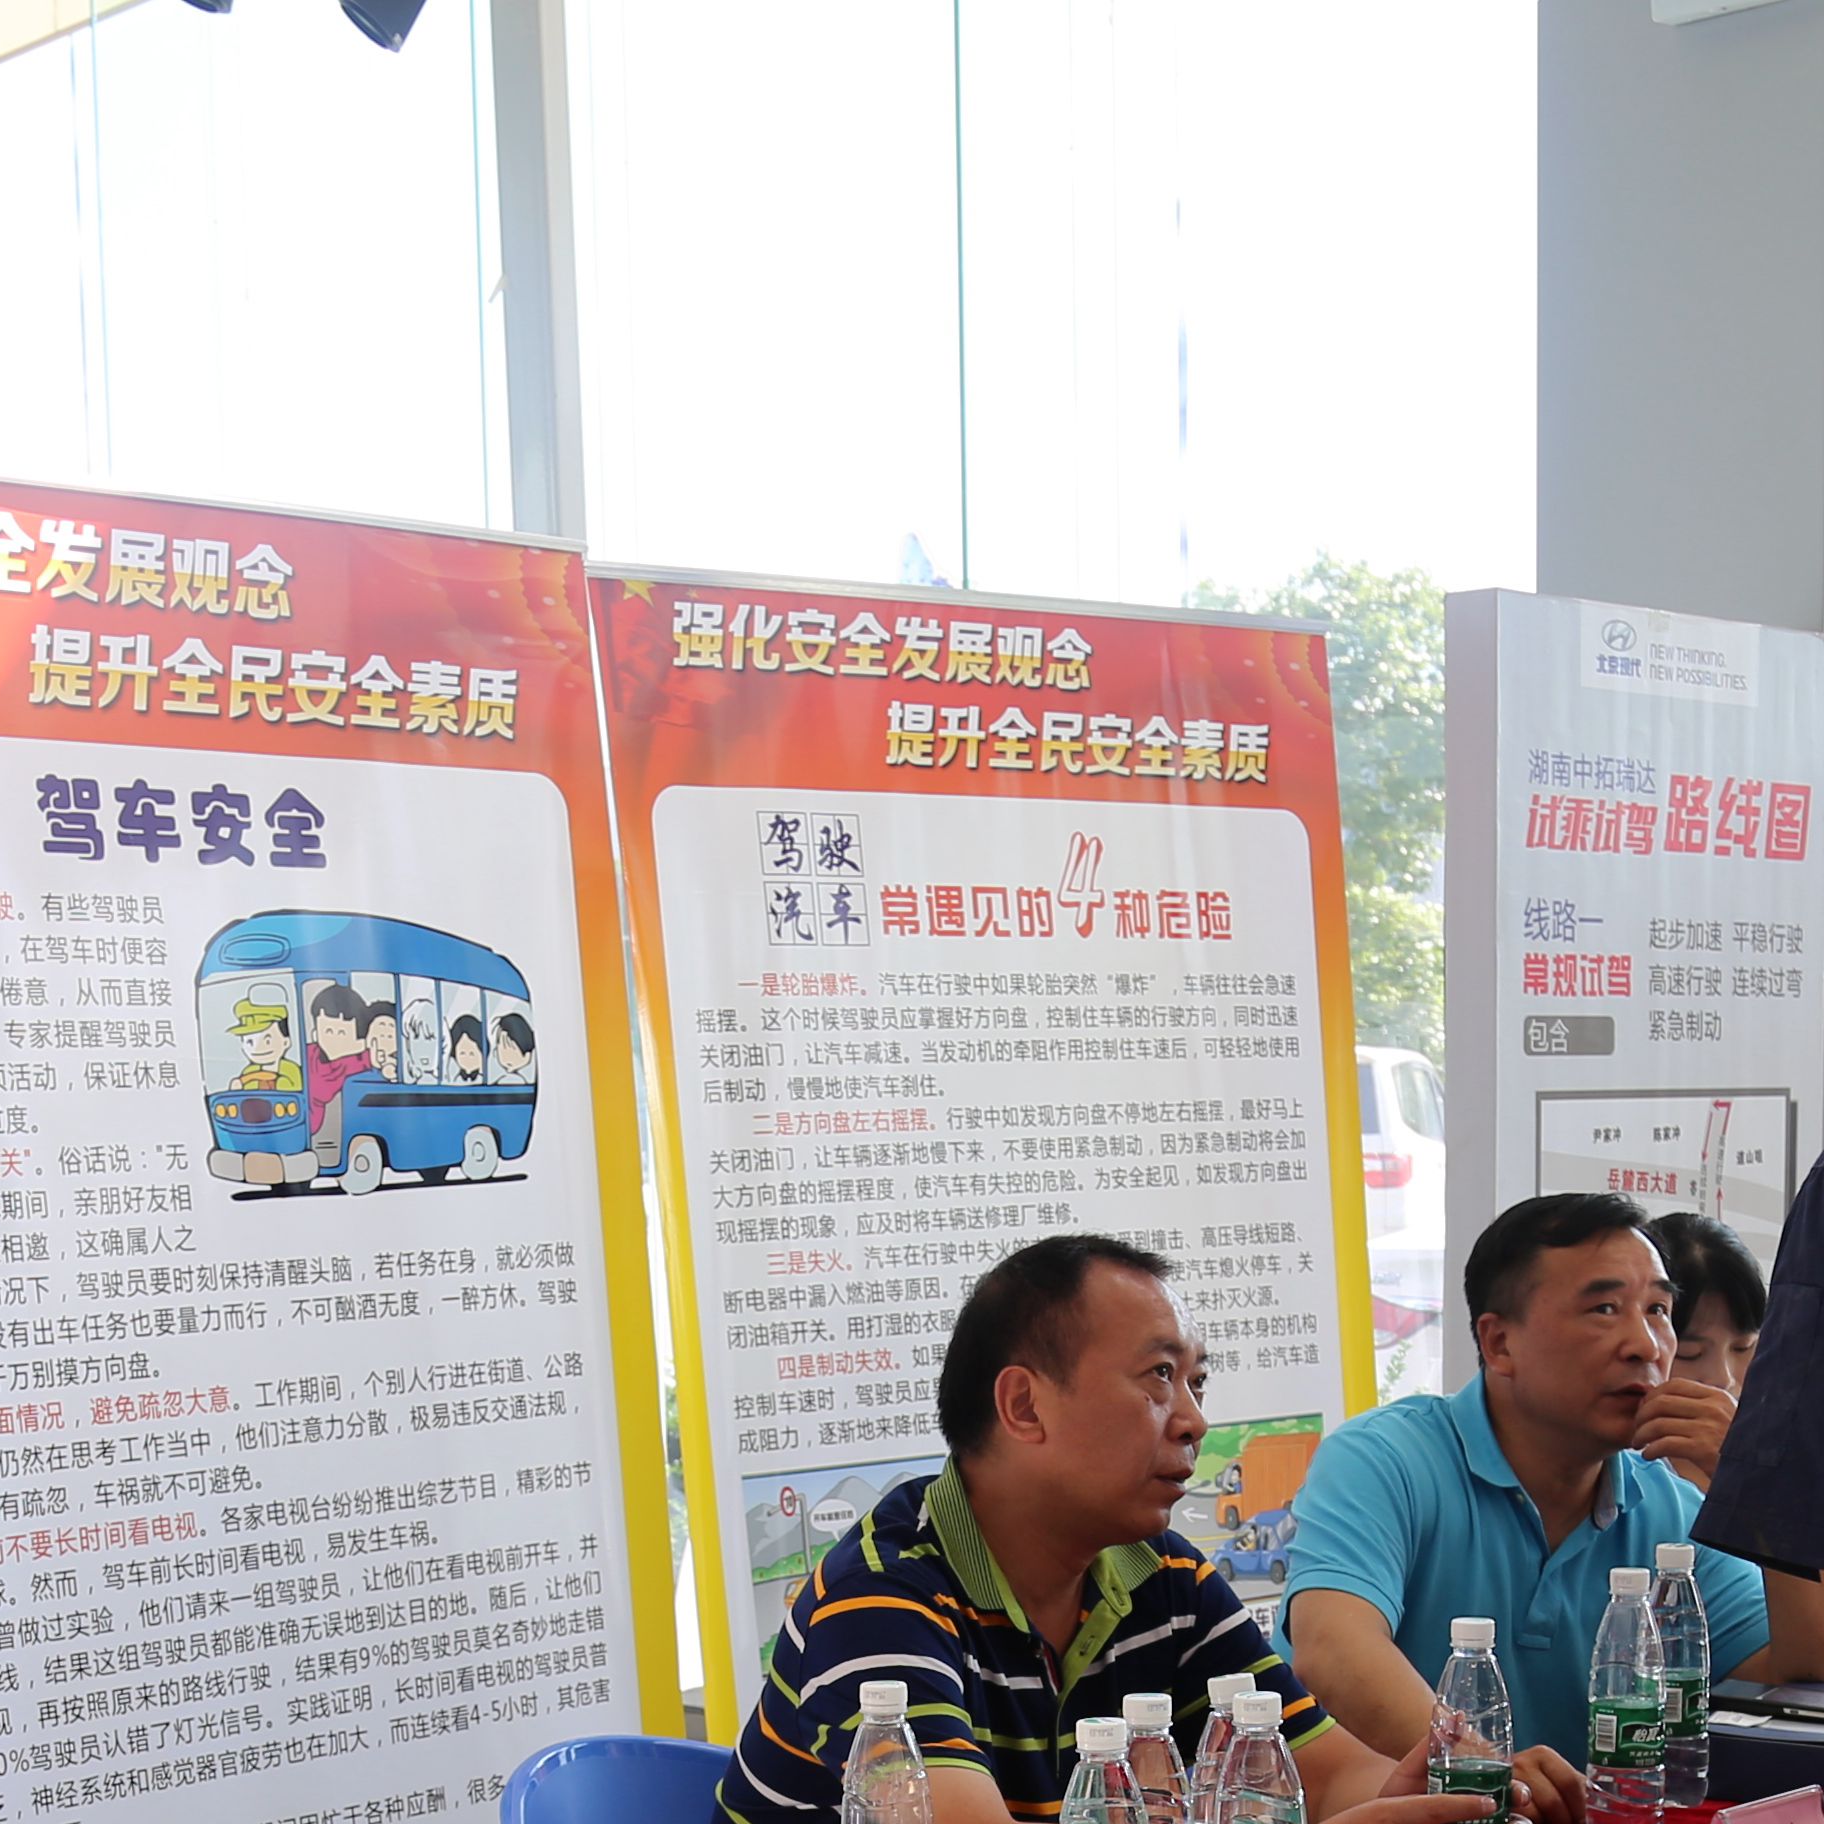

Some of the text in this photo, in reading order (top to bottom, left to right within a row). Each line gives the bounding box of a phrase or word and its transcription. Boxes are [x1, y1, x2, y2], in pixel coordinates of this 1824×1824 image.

[673, 602, 1093, 691] 强化安全发展观念
[1596, 653, 1642, 678] 北京现代
[1650, 643, 1673, 660] NEW
[29, 626, 518, 740] 提升全民安全素质
[1649, 663, 1674, 681] NEW
[886, 701, 1270, 784] 提升全民安全素质
[1527, 748, 1656, 796] 湖南中拓瑞达
[36, 774, 328, 870] 驾车安全
[1526, 774, 1812, 862] 试乘试驾 路线图
[763, 814, 863, 873] 驾驶
[880, 831, 1233, 940] 常遇见的4种危险
[769, 884, 862, 944] 汽车
[1523, 897, 1604, 944] 线路一
[1648, 916, 1804, 955] 起步加速 平稳行驶
[1523, 953, 1632, 998] 常规试驾
[1648, 964, 1804, 999] 高速行驶 连续过弯
[1527, 1018, 1570, 1055] 包含
[1648, 1008, 1722, 1043] 紧急制动
[703, 1074, 947, 1105] 后制动，慢慢地使汽车刹住。
[1607, 1167, 1679, 1196] 岳麓西大道
[716, 1202, 1080, 1244] 现摇摆的现象，应及时将车辆送修理厂维修。
